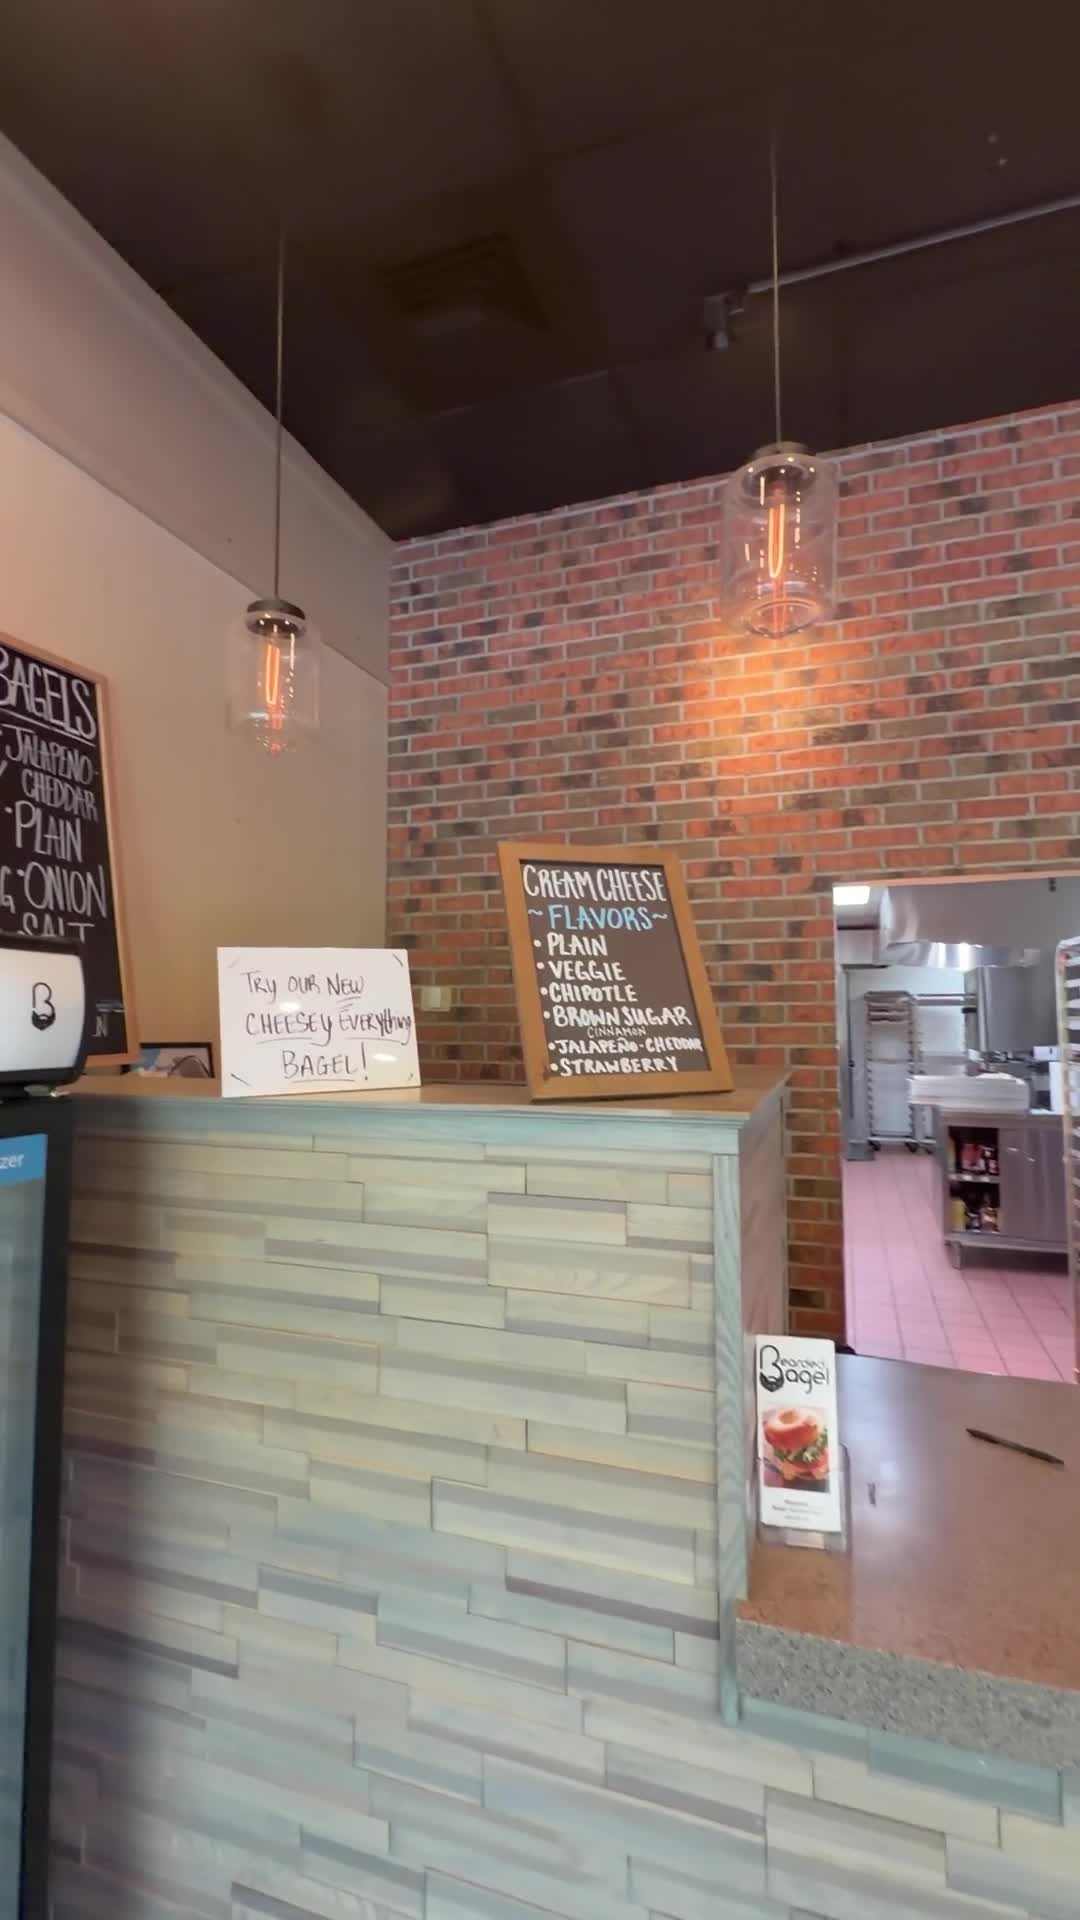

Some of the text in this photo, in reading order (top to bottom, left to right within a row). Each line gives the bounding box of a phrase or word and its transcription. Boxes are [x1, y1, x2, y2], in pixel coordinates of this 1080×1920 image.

[21, 768, 99, 822] CHEDDAR
[15, 800, 83, 863] PLAIN
[24, 861, 107, 918] ONION
[523, 864, 668, 902] CREAM CHEESE
[547, 932, 608, 956] PLAIN
[548, 960, 627, 981] VEGGIE
[549, 982, 638, 1003] CHIPOTLE
[552, 1005, 692, 1028] BROWN SUGAR
[586, 1026, 647, 1039] CINNAMON
[560, 1055, 678, 1077] STRAWBERRY
